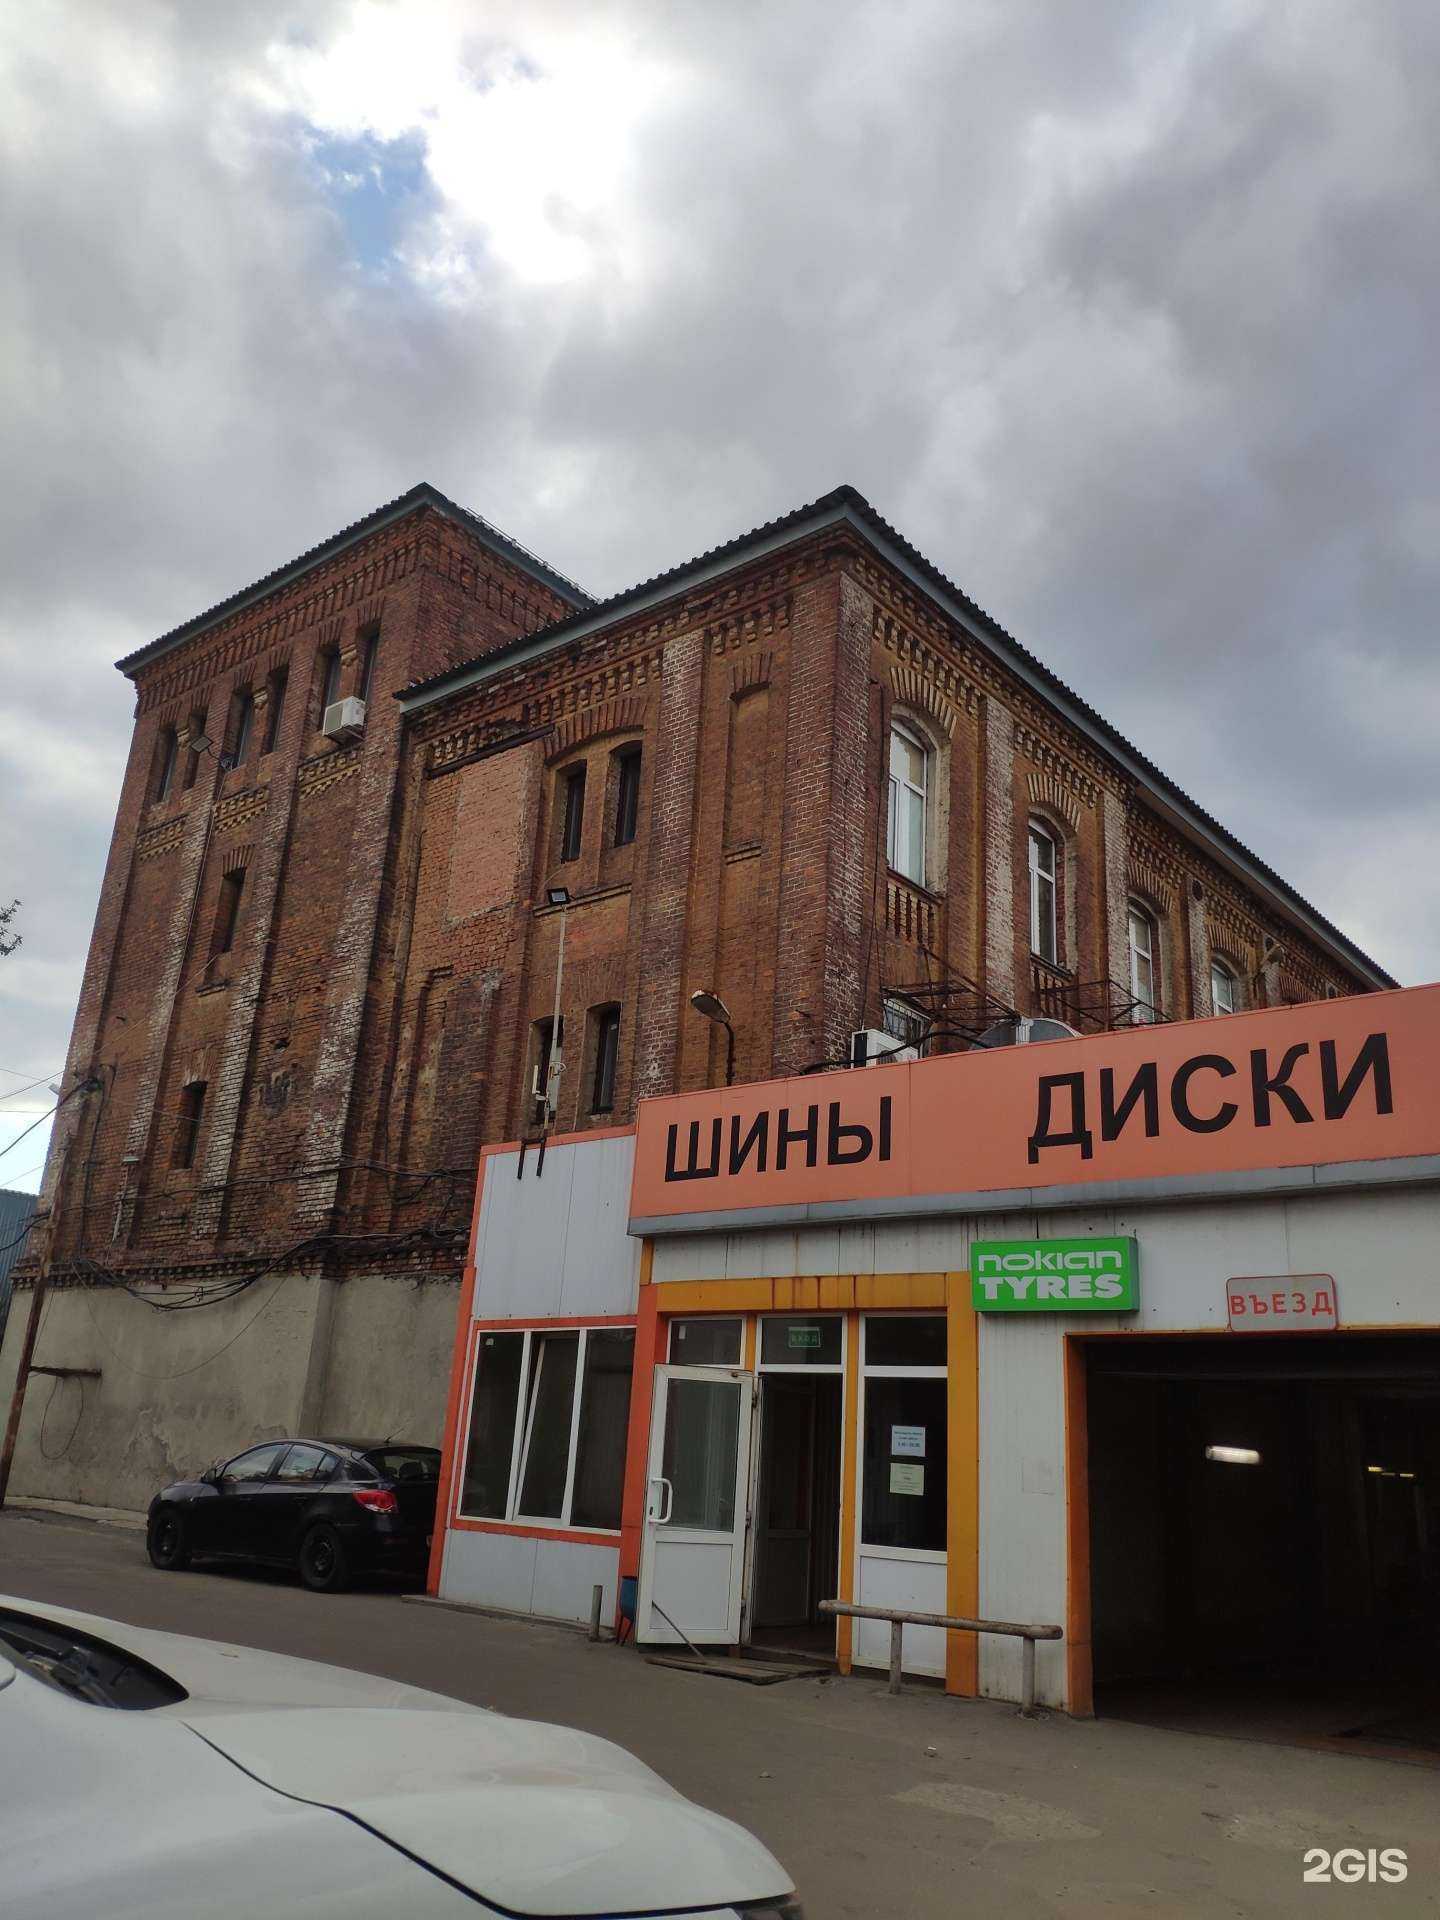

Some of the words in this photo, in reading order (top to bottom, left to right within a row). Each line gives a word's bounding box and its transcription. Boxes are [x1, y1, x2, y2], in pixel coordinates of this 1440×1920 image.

[665, 1096, 892, 1182] ШИНЫ
[1028, 1033, 1393, 1165] ДИСКИ
[978, 1273, 1123, 1300] TYRES
[1230, 1291, 1333, 1316] ВЪЕЗД
